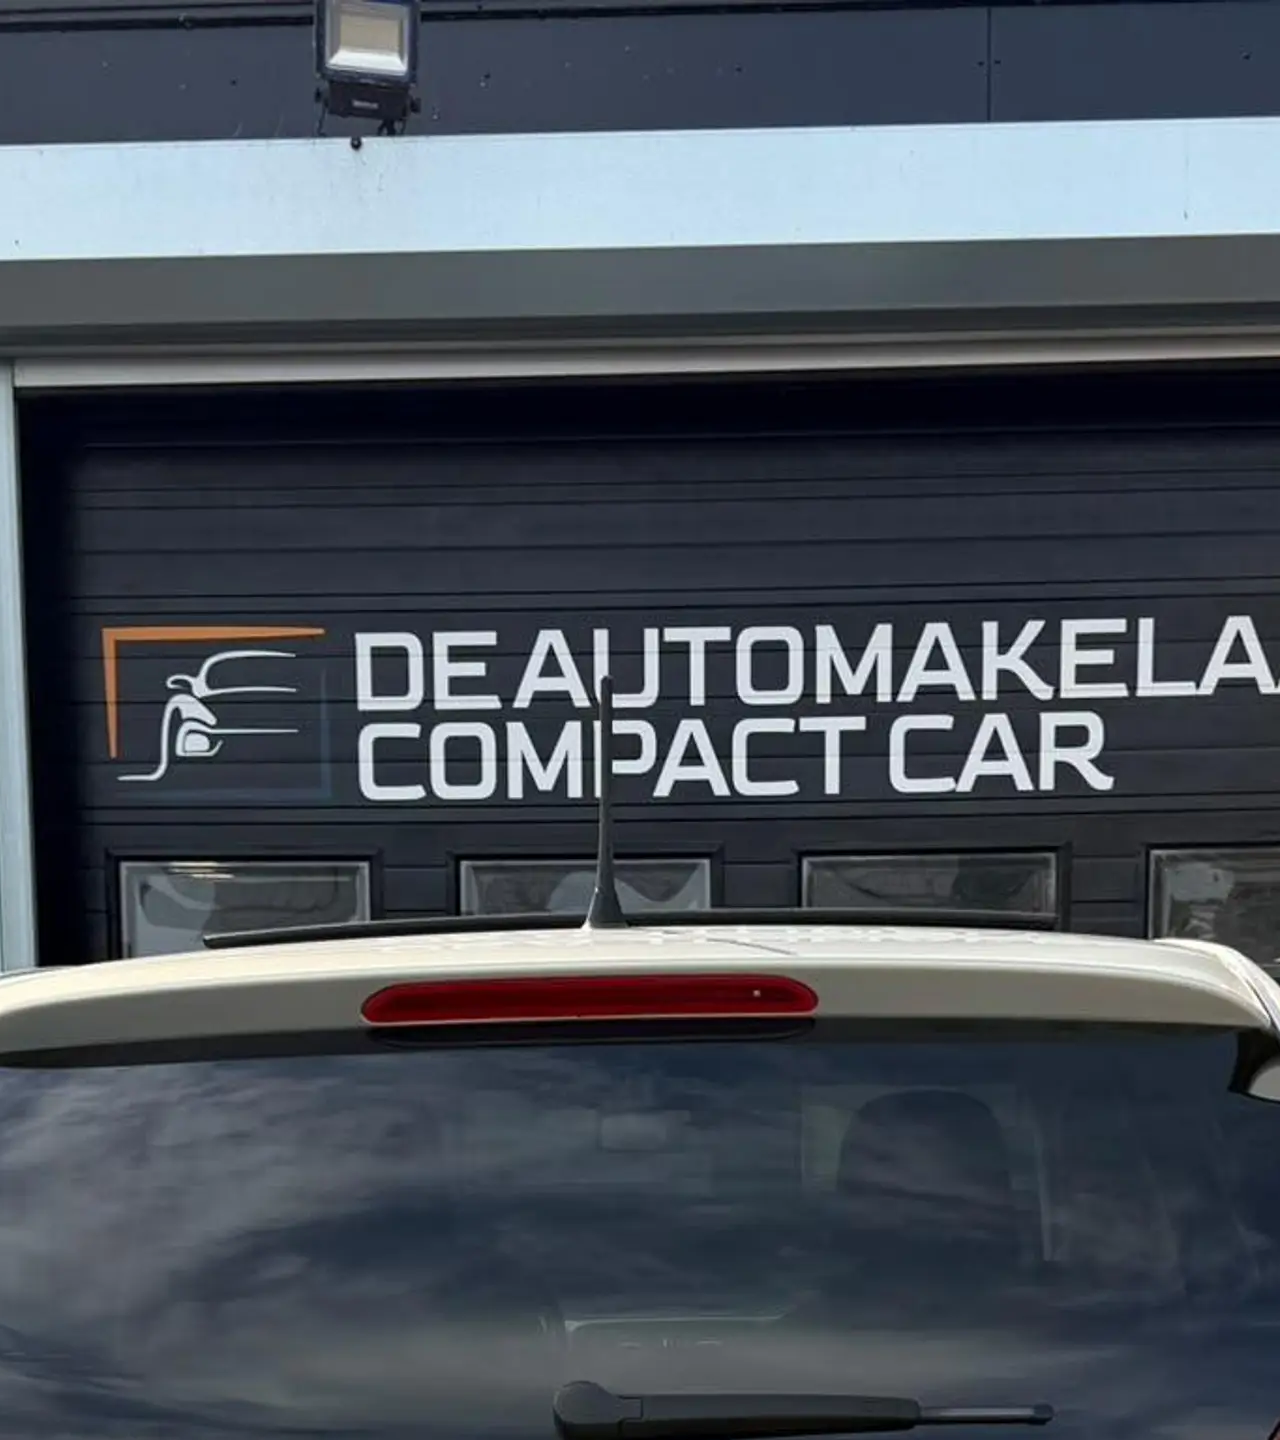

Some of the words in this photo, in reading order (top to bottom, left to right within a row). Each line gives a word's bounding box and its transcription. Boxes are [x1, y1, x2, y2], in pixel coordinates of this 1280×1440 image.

[353, 629, 502, 711] DE
[358, 715, 865, 800] COMPACT
[888, 711, 1113, 793] CAR
